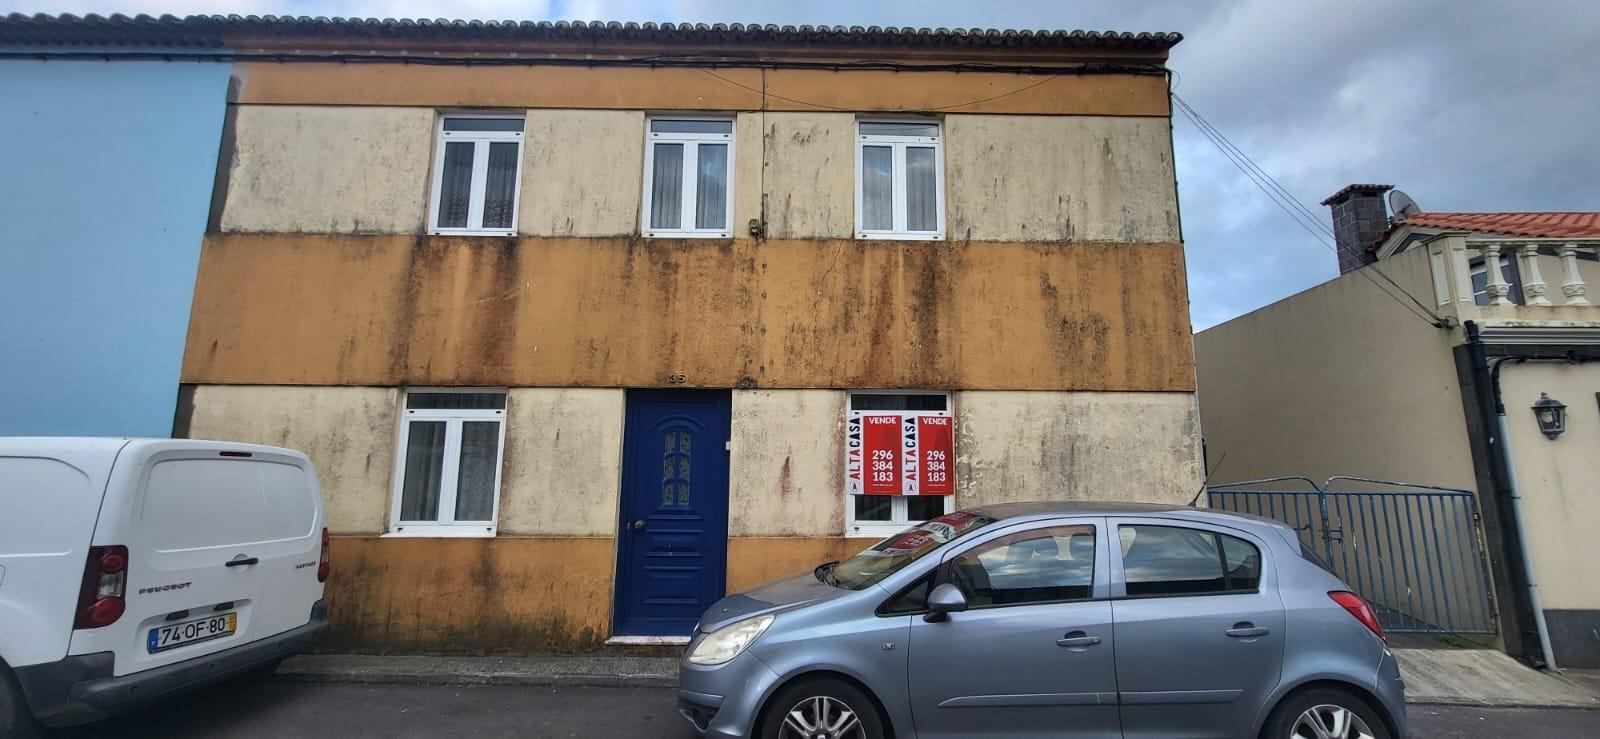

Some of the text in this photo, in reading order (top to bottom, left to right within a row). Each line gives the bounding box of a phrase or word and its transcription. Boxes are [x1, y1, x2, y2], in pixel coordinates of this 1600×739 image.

[670, 374, 686, 384] 35
[869, 417, 897, 425] VENDE
[923, 417, 948, 425] VENDE
[849, 418, 861, 480] ALTACASA
[905, 418, 917, 481] ALTACASA
[872, 450, 893, 460] 296
[926, 450, 946, 460] 296
[872, 461, 893, 471] 384
[926, 461, 946, 471] 384
[872, 471, 894, 482] 183
[927, 471, 946, 482] 183
[138, 582, 192, 594] PEUGEOT
